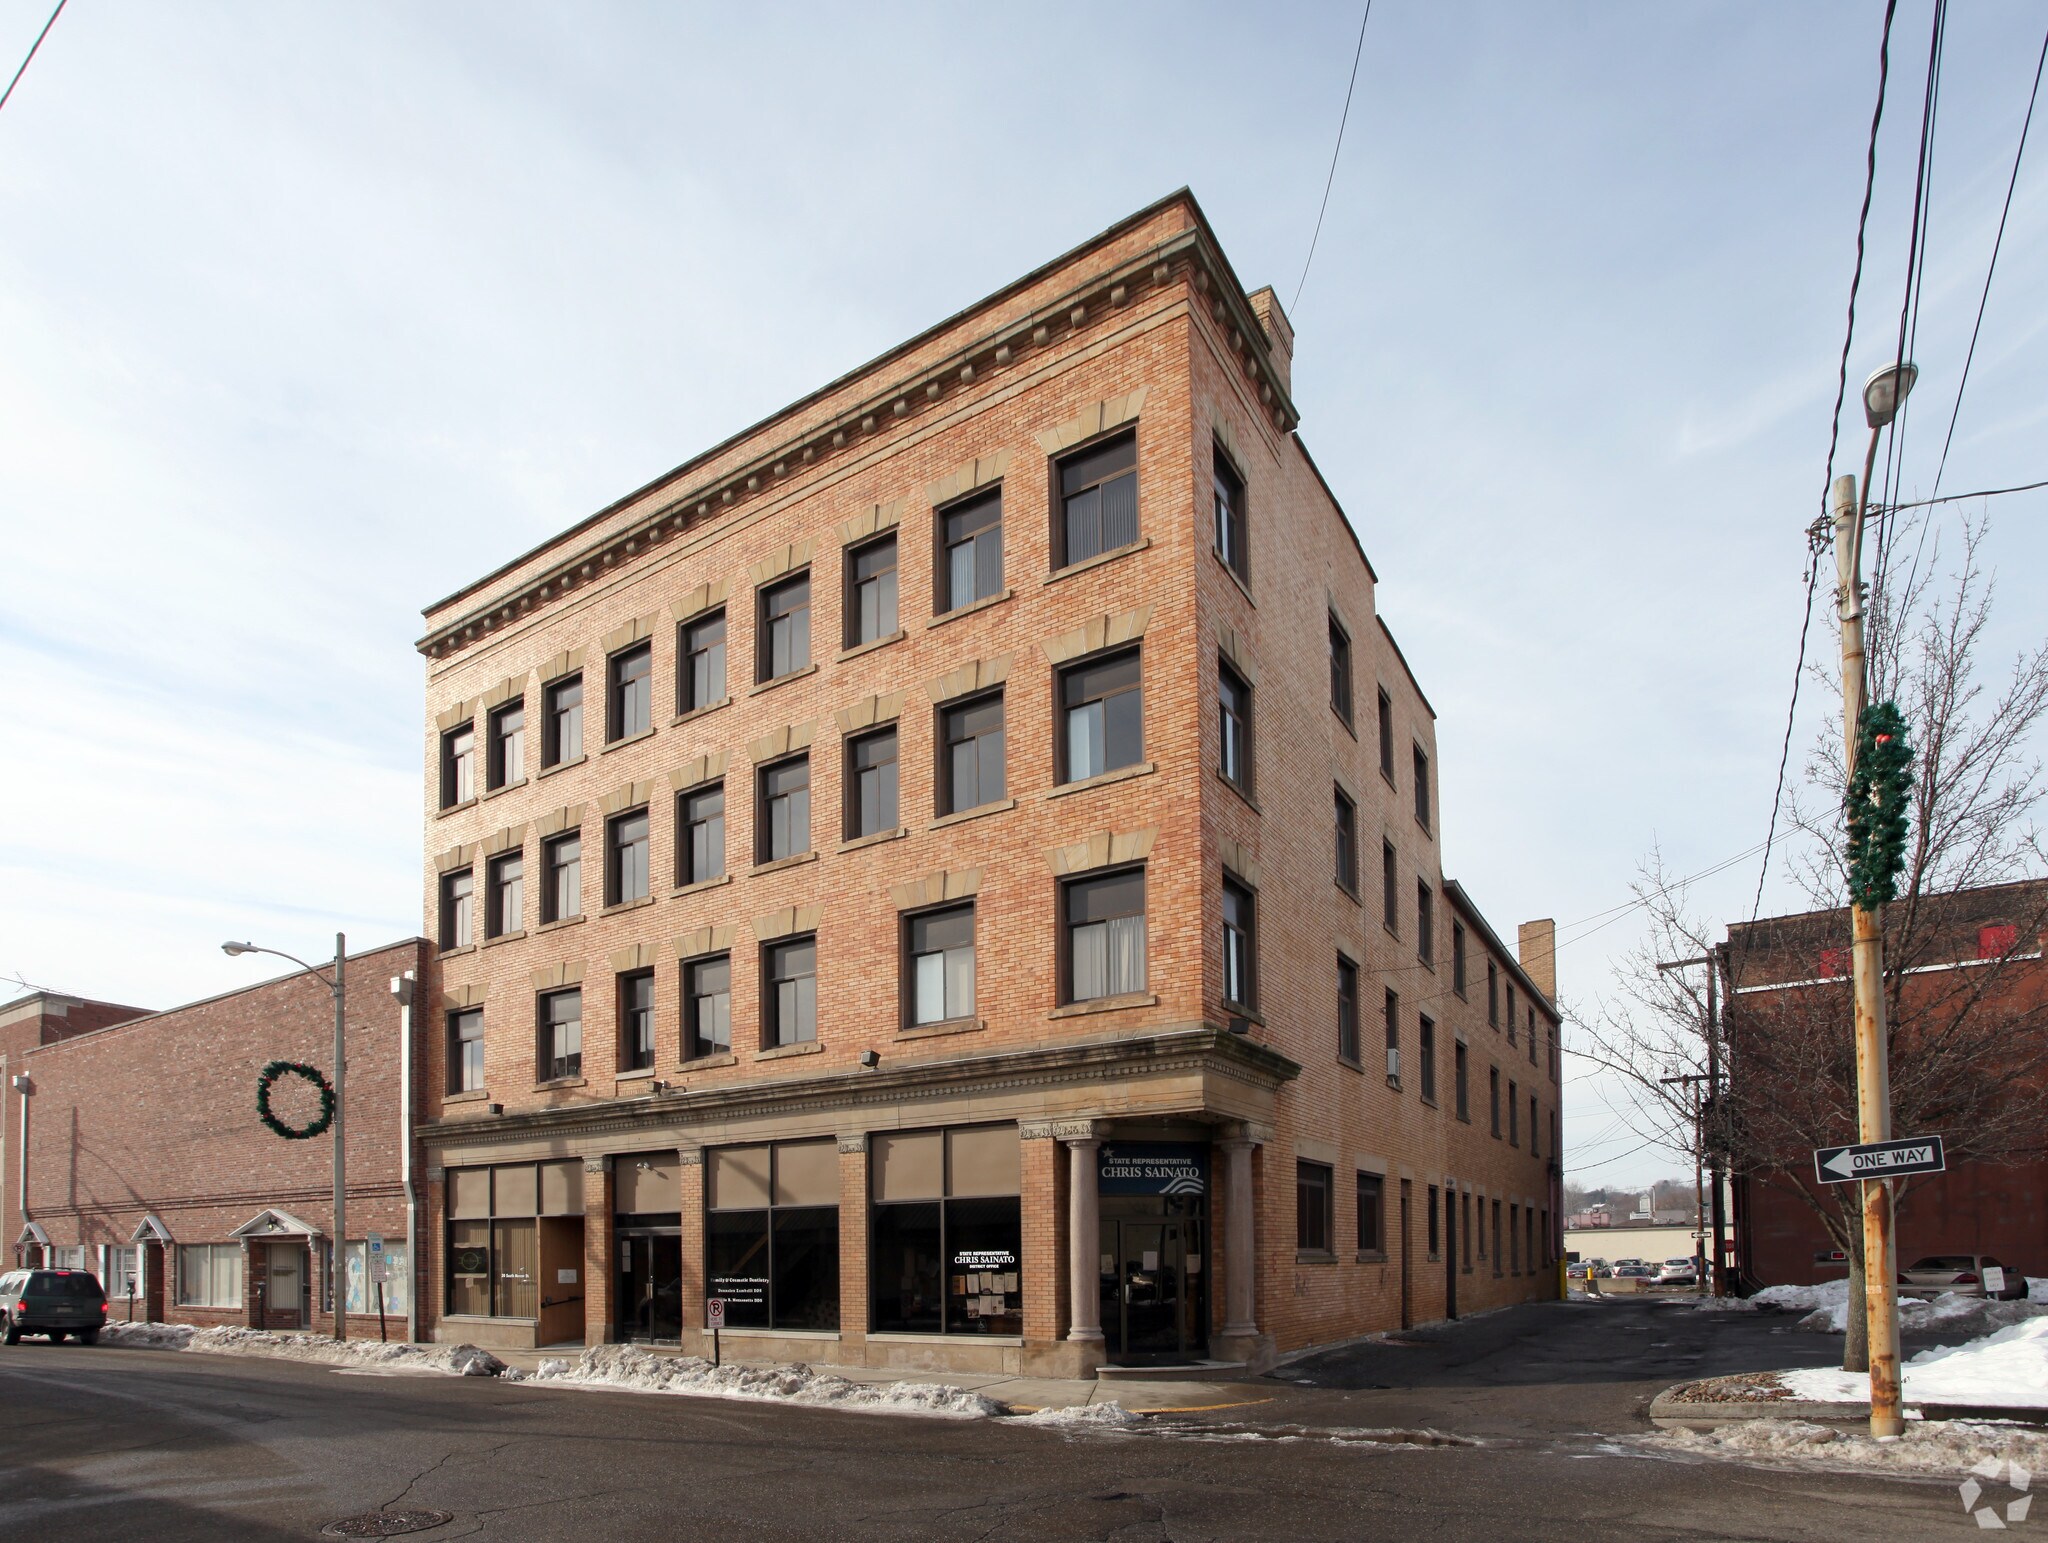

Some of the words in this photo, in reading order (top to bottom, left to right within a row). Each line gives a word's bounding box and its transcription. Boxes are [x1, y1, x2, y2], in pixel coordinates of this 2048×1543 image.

[1108, 1157, 1131, 1165] STATE
[1132, 1157, 1192, 1165] REPRESENTATIVE
[1853, 1153, 1887, 1168] ONE
[1892, 1148, 1927, 1164] WAY
[1101, 1166, 1142, 1178] CHRIS
[1144, 1166, 1200, 1178] SAINATO
[954, 1256, 979, 1264] CHRIS
[980, 1255, 1015, 1264] SAINATO
